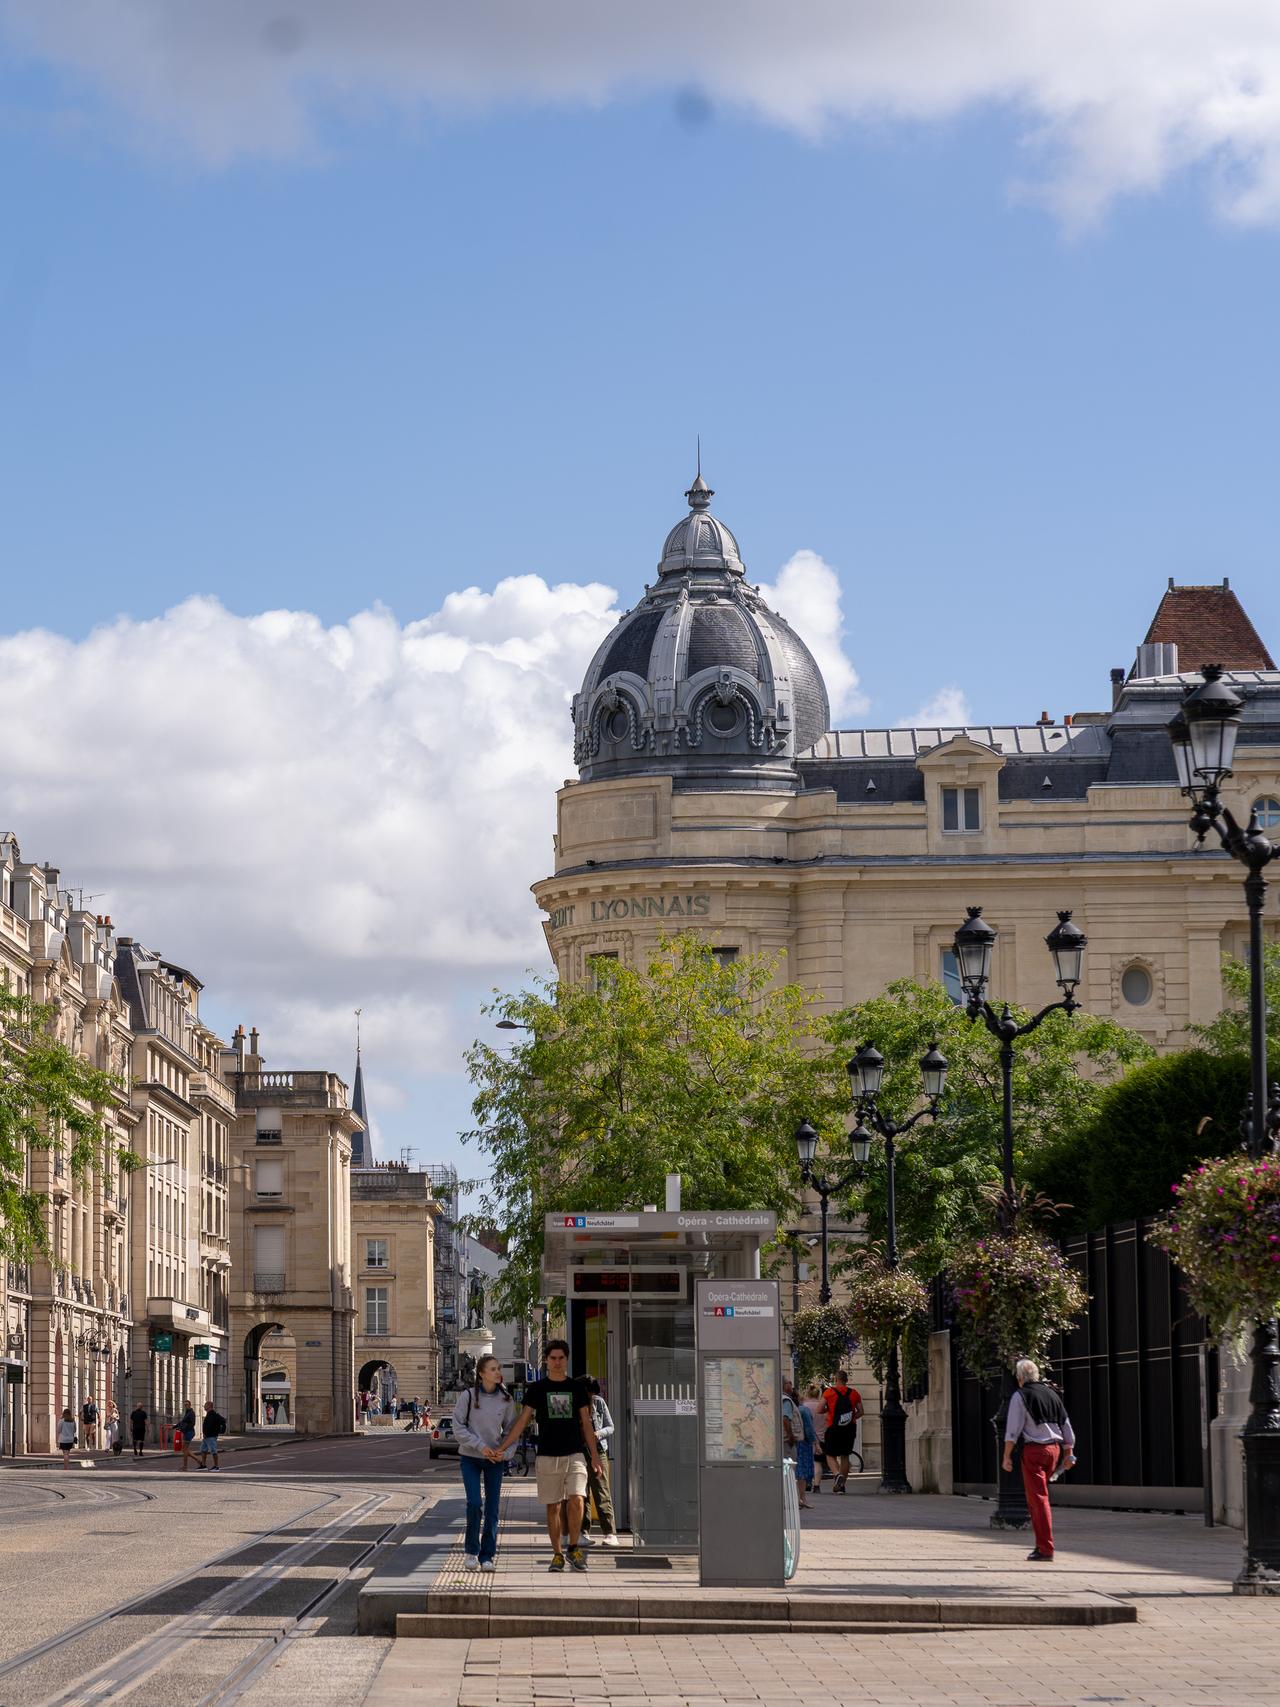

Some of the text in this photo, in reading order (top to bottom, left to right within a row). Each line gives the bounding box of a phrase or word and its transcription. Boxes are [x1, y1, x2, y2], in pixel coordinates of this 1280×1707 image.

[590, 895, 710, 922] LYONNAIS
[678, 1216, 707, 1228] Opéra
[716, 1215, 769, 1225] Cathédrale
[708, 1291, 769, 1303] Opéra-Cathédrale
[716, 1308, 723, 1316] A
[726, 1308, 732, 1316] B
